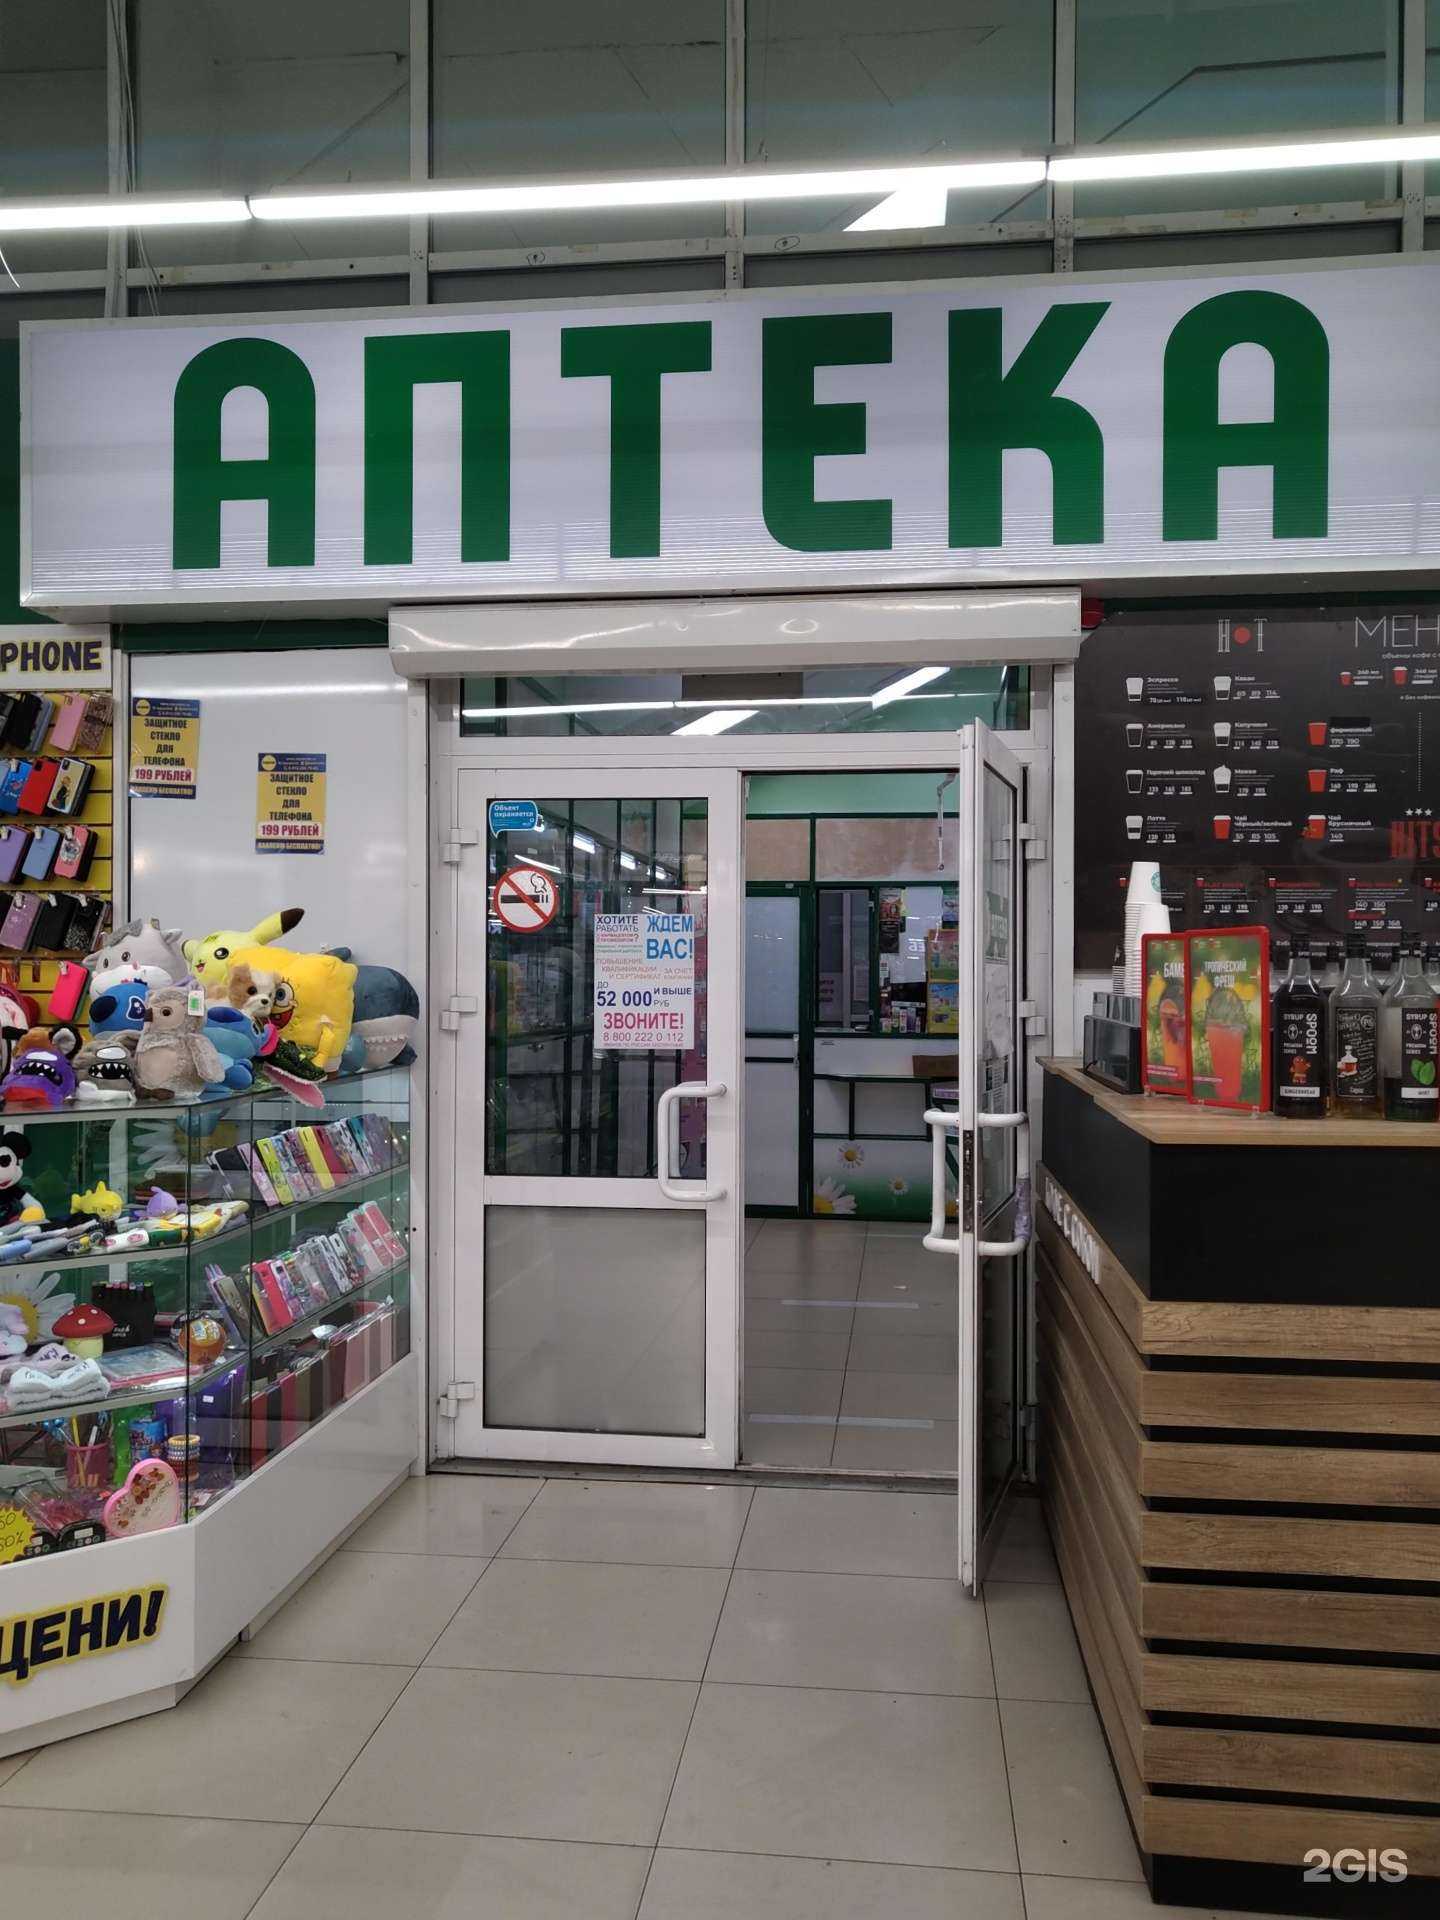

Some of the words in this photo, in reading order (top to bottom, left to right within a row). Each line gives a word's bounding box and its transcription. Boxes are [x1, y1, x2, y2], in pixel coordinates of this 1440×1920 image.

[173, 290, 1328, 569] АПТЕКА
[0, 641, 102, 672] PHONE
[144, 719, 187, 729] ЗАЩИТНОЕ
[150, 730, 180, 741] СТЕКЛО
[156, 744, 173, 753] ДЛЯ
[143, 756, 185, 766] ТЕЛЕФОНА
[135, 769, 153, 779] 199
[155, 769, 192, 781] РУБЛЕЙ
[270, 774, 314, 783] ЗАЩИТНОЕ
[276, 786, 307, 795] СТЕКЛО
[282, 799, 300, 808] ДЛЯ
[269, 811, 312, 821] ТЕЛЕФОНА
[261, 825, 279, 835] 199
[281, 823, 319, 836] РУБЛЕЙ
[596, 915, 639, 924] ХОТИТЕ
[647, 915, 693, 932] ЖДЕМ
[596, 924, 639, 932] РАБОТАТЬ
[646, 938, 693, 959] ВАС!
[1204, 958, 1247, 973] ТРОПИЧЕСКИЙ
[597, 981, 609, 989] ДО
[1214, 975, 1235, 988] ФРЕШ
[662, 987, 692, 995] ВЫШЕ
[597, 990, 616, 1007] 52
[622, 990, 652, 1007] 000
[603, 1012, 684, 1029] ЗВОНИТЕ!
[1284, 1013, 1304, 1021] SYRUP
[1406, 1013, 1428, 1021] SYRUP
[603, 1032, 609, 1041] 8
[613, 1032, 631, 1041] 800
[635, 1032, 653, 1041] 222
[656, 1032, 662, 1041] 0
[667, 1032, 684, 1041] 112
[1306, 1013, 1317, 1054] SPOOM
